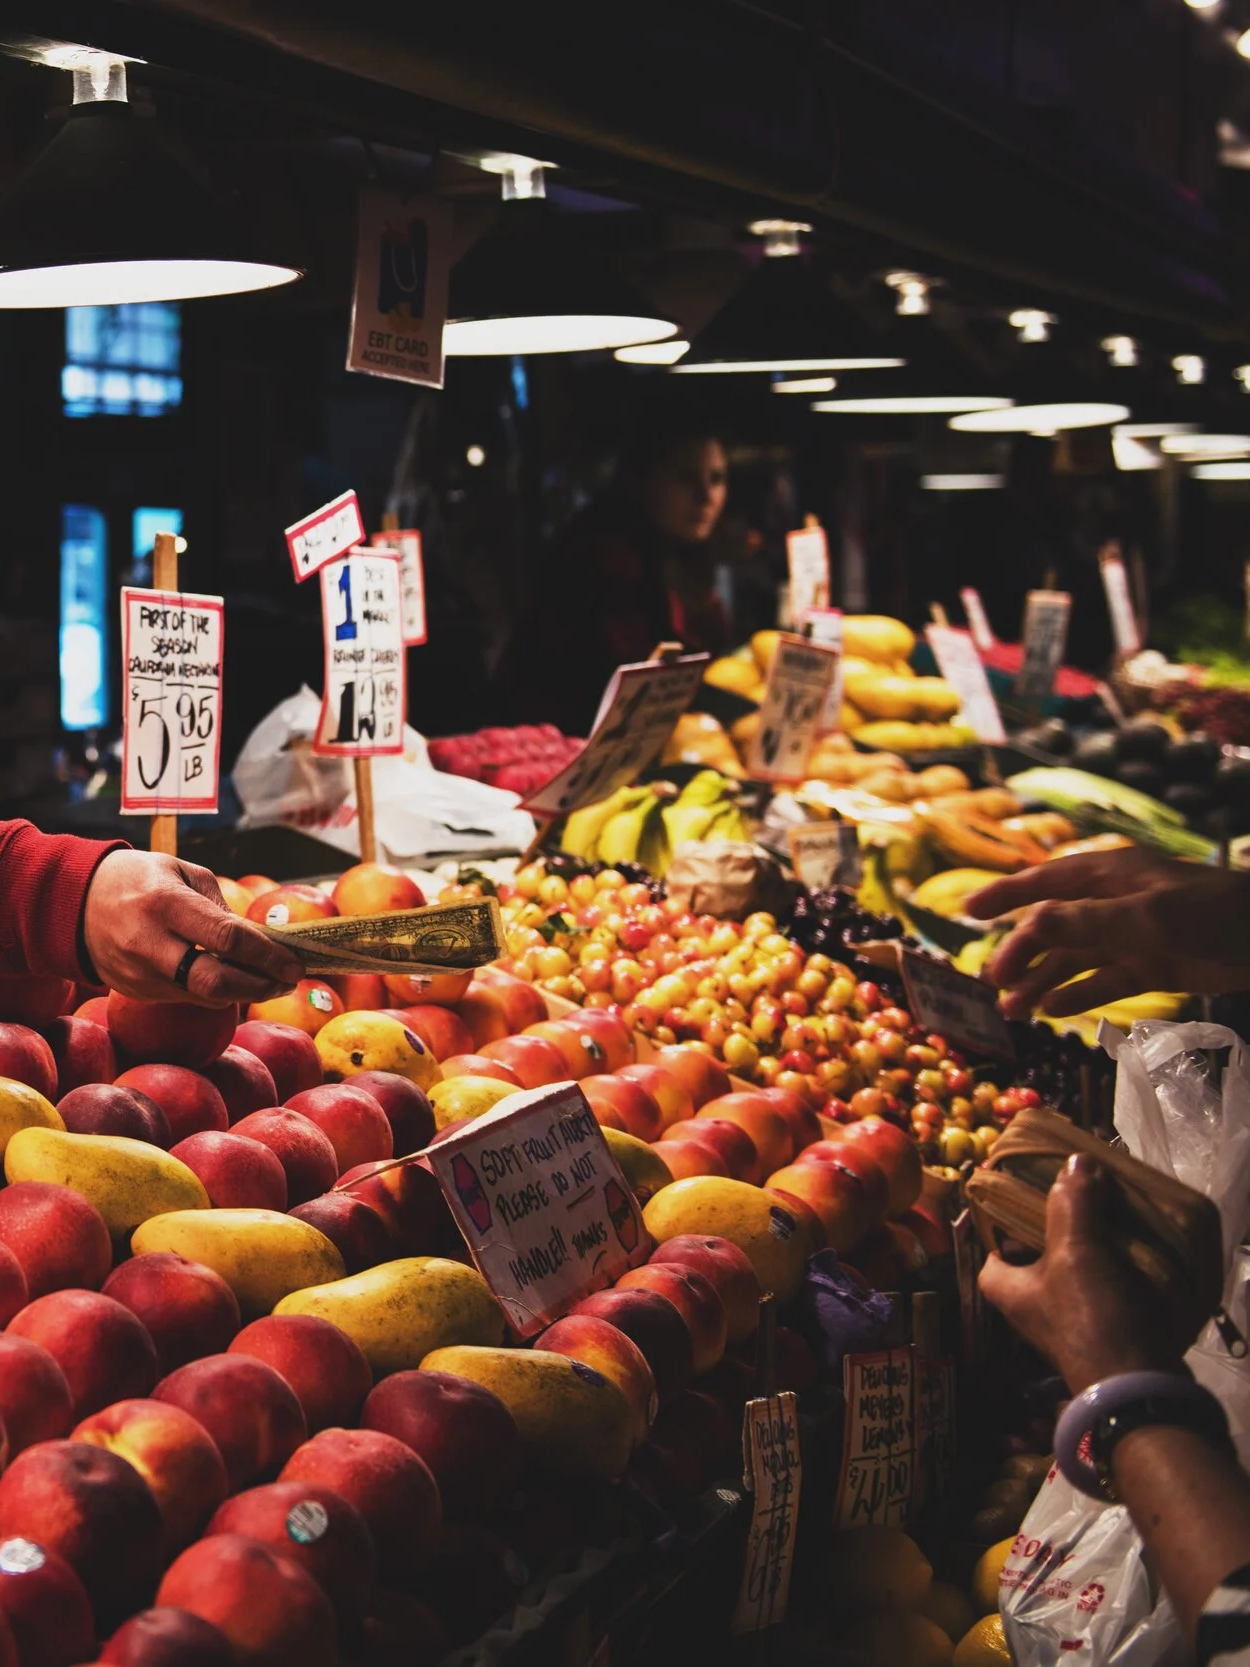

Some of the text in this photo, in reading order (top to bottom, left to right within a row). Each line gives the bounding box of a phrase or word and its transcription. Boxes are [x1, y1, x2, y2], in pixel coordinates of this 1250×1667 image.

[368, 330, 429, 357] EBT CARD
[362, 349, 407, 369] ACCEPTED
[141, 606, 209, 635] FIRST OF THE
[151, 635, 198, 657] SEASON
[176, 693, 213, 739] 95
[184, 755, 203, 782] LB
[480, 1142, 523, 1186] SOFT
[522, 1127, 562, 1165] FRUIT
[496, 1151, 599, 1227] PLEASE DO NOT
[572, 1221, 608, 1259] THANKS
